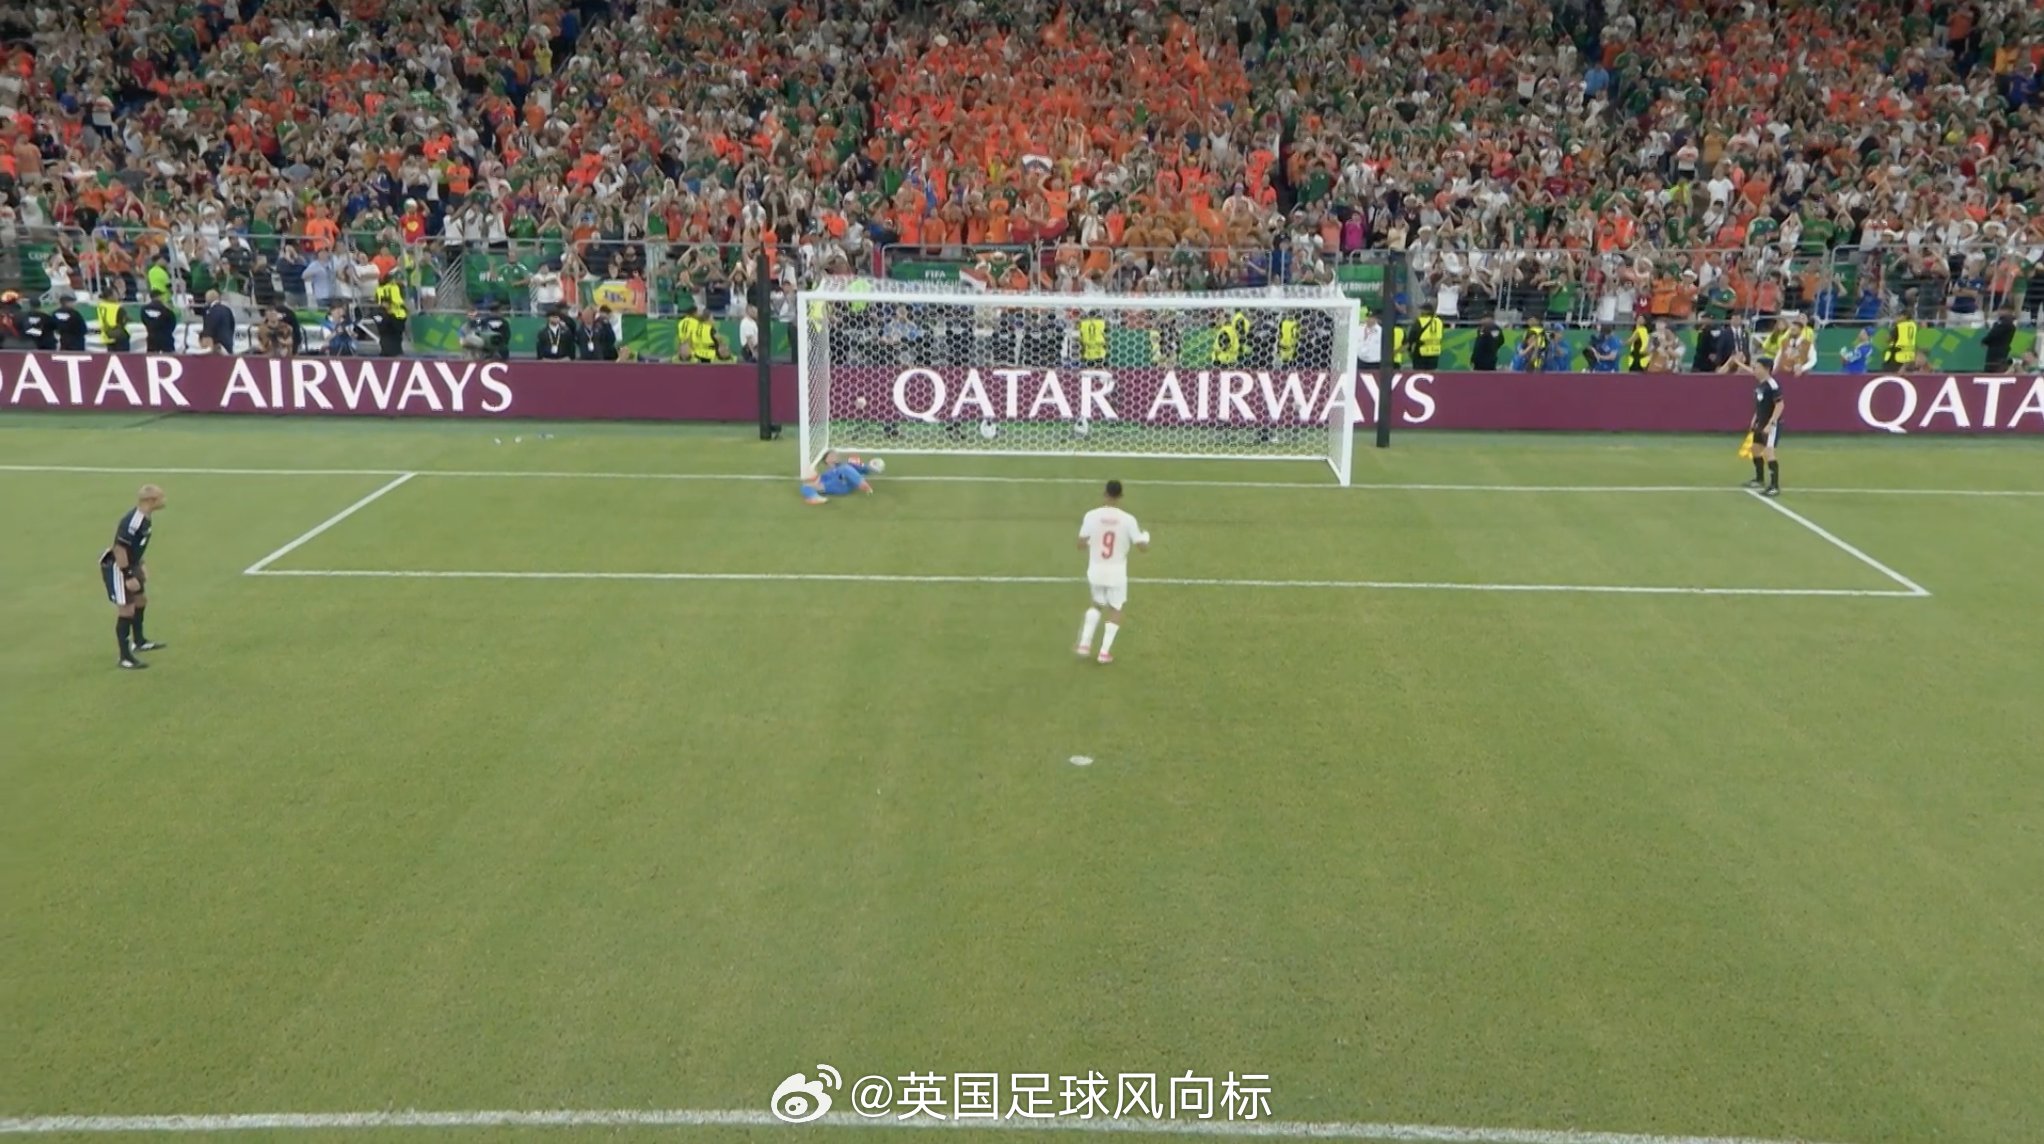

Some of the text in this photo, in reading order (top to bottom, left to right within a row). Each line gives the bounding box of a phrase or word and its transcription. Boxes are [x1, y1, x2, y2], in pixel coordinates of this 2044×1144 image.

[925, 269, 946, 279] FIFA
[0, 353, 513, 412] ATAR AIRWAYS
[893, 368, 1437, 423] QATAR AIRWAYS
[1858, 376, 2044, 433] QATA
[1101, 530, 1116, 560] 9
